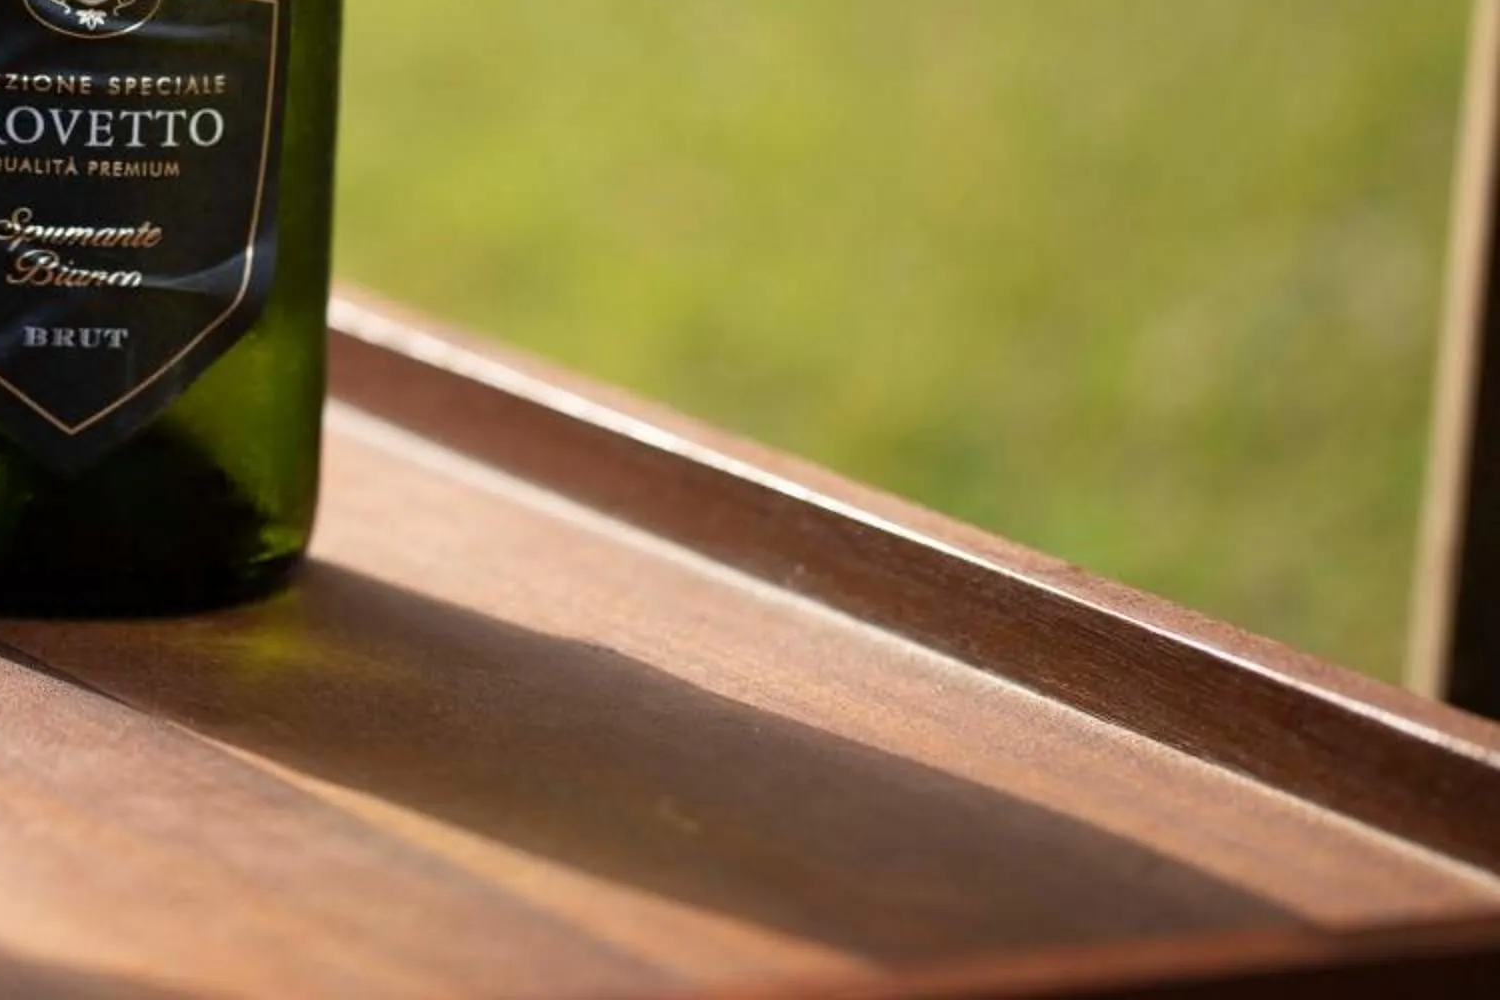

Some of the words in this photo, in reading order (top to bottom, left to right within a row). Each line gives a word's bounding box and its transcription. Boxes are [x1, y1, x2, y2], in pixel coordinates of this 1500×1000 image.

[108, 73, 228, 96] SPECIALE
[88, 160, 181, 178] PREMIUM
[5, 249, 143, 289] Bianco
[22, 326, 129, 350] BRUT
